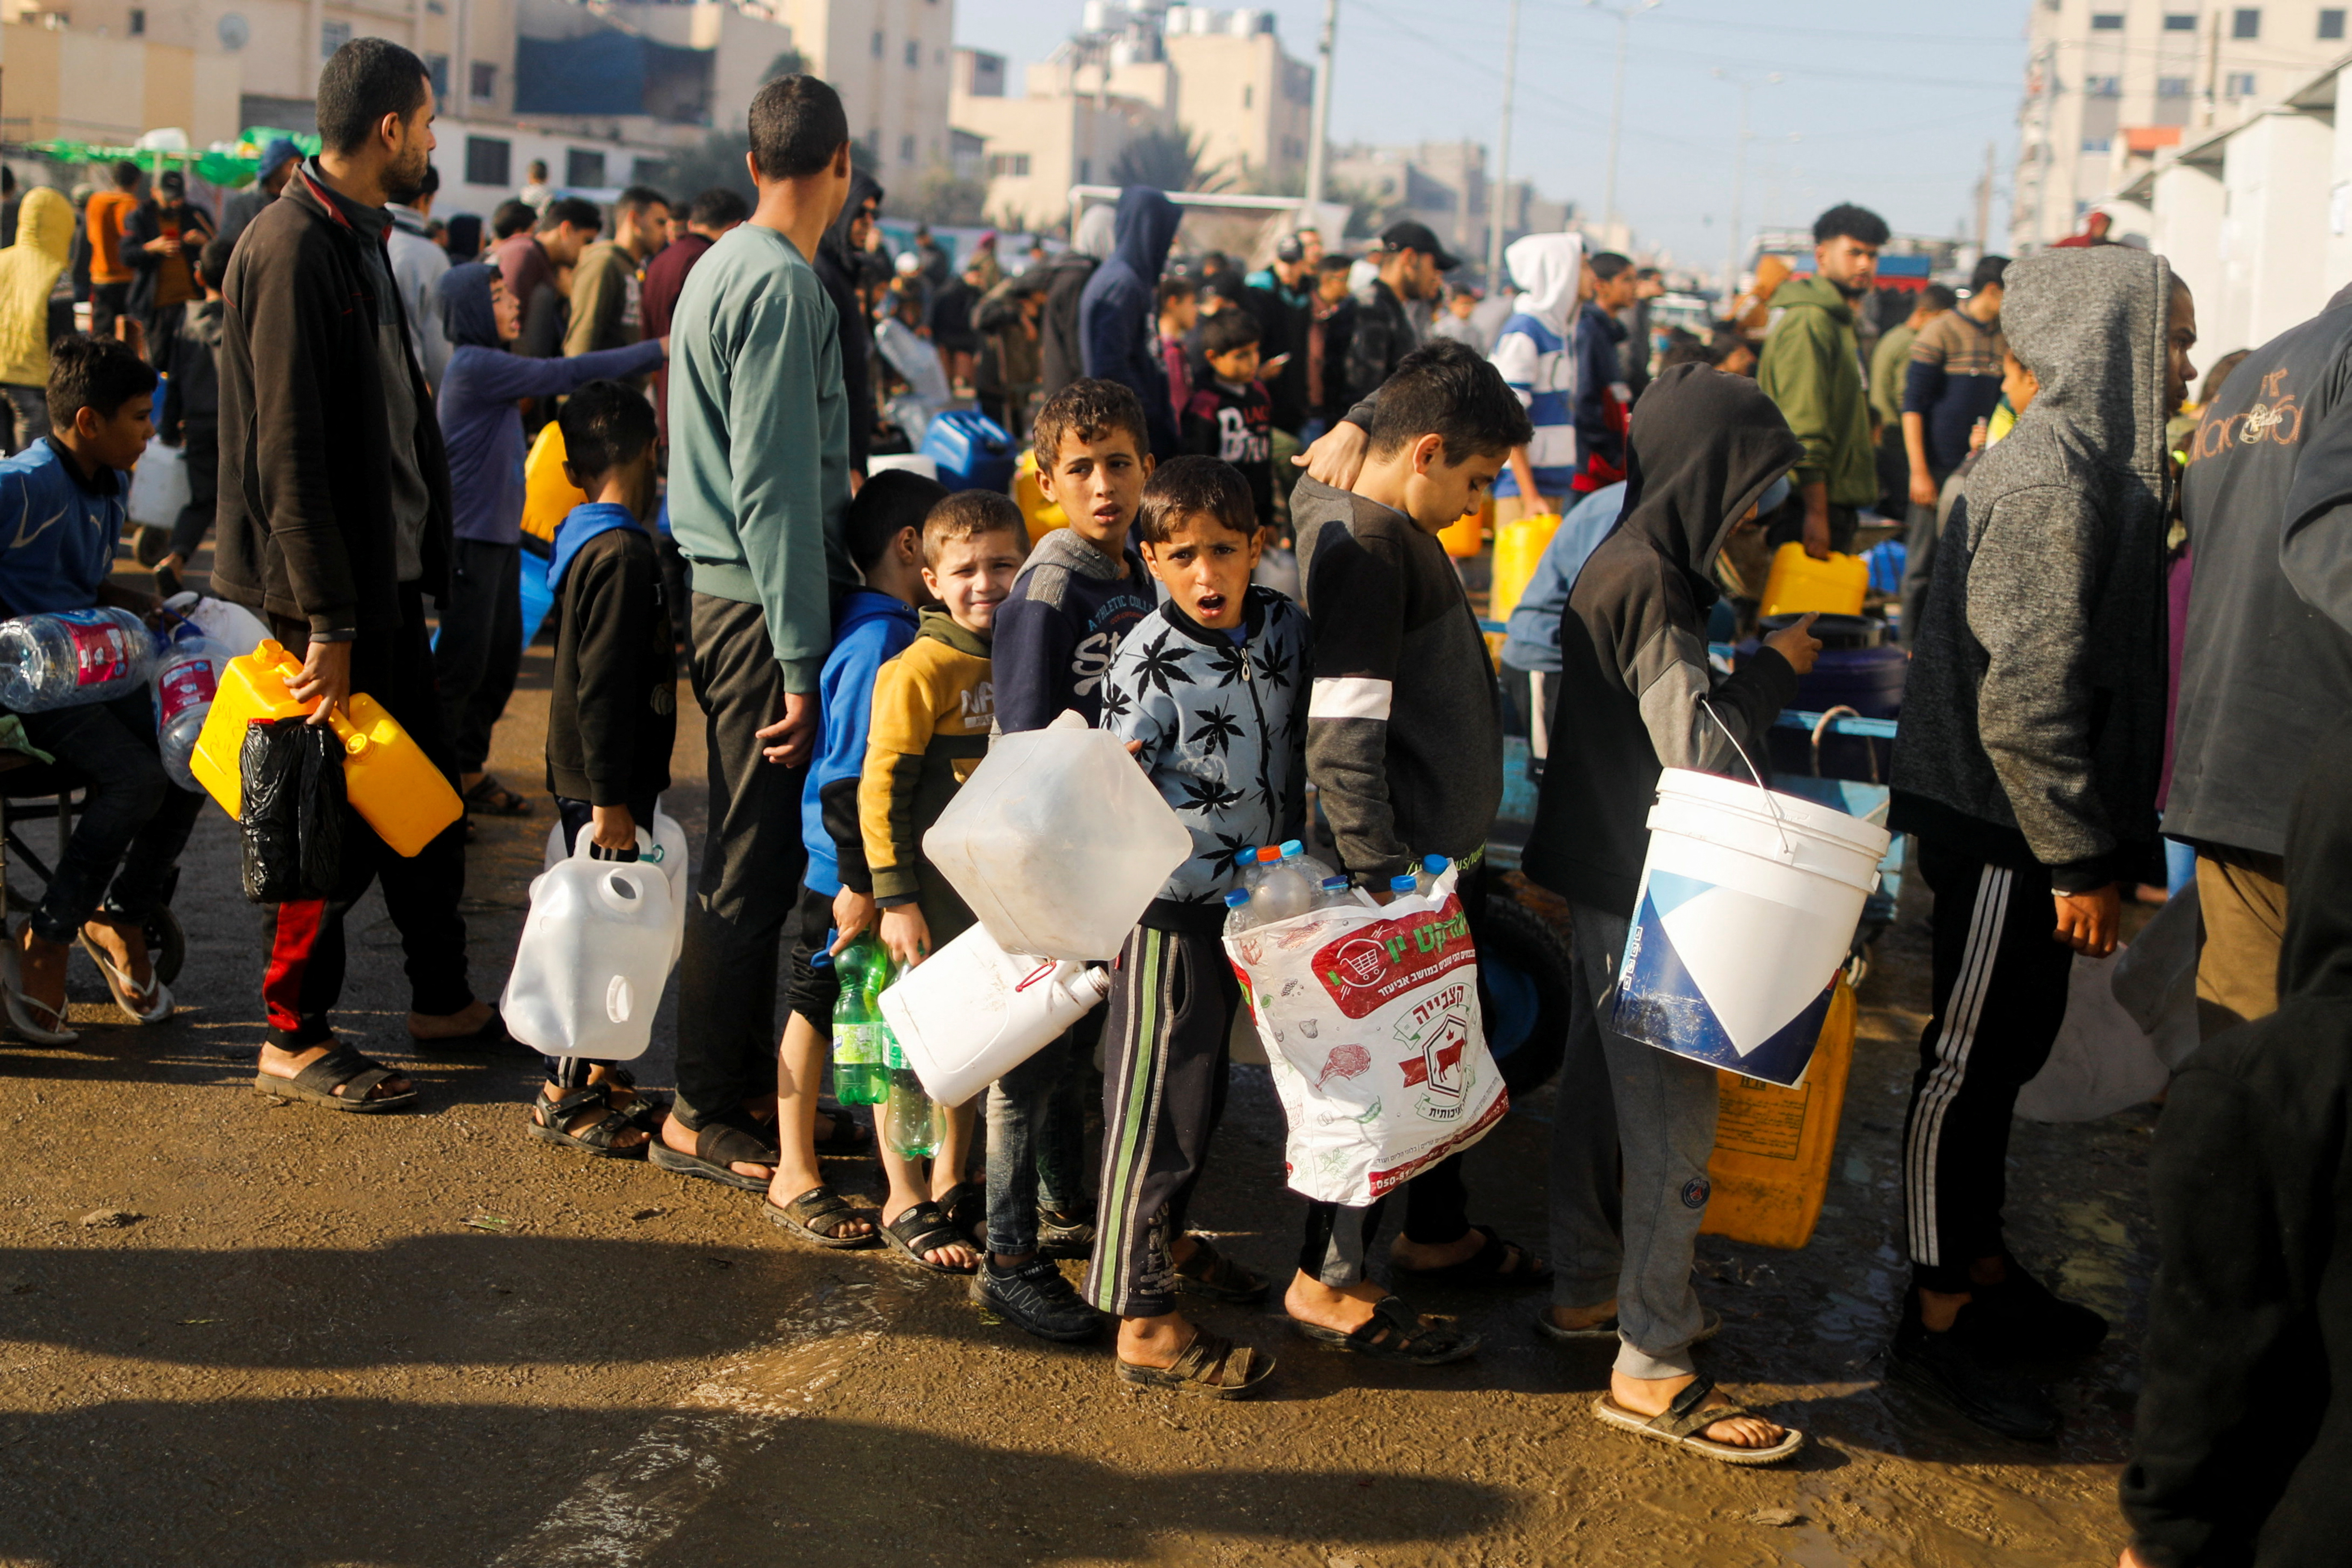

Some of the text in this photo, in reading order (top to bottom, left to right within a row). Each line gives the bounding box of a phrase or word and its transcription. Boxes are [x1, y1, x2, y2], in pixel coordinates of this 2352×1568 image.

[1088, 595, 1126, 632] ATHLETIC
[1411, 964, 1438, 982] במושב
[1439, 955, 1452, 970] טובים
[1378, 976, 1410, 997] אביעזר
[1412, 986, 1464, 1025] קצבייה
